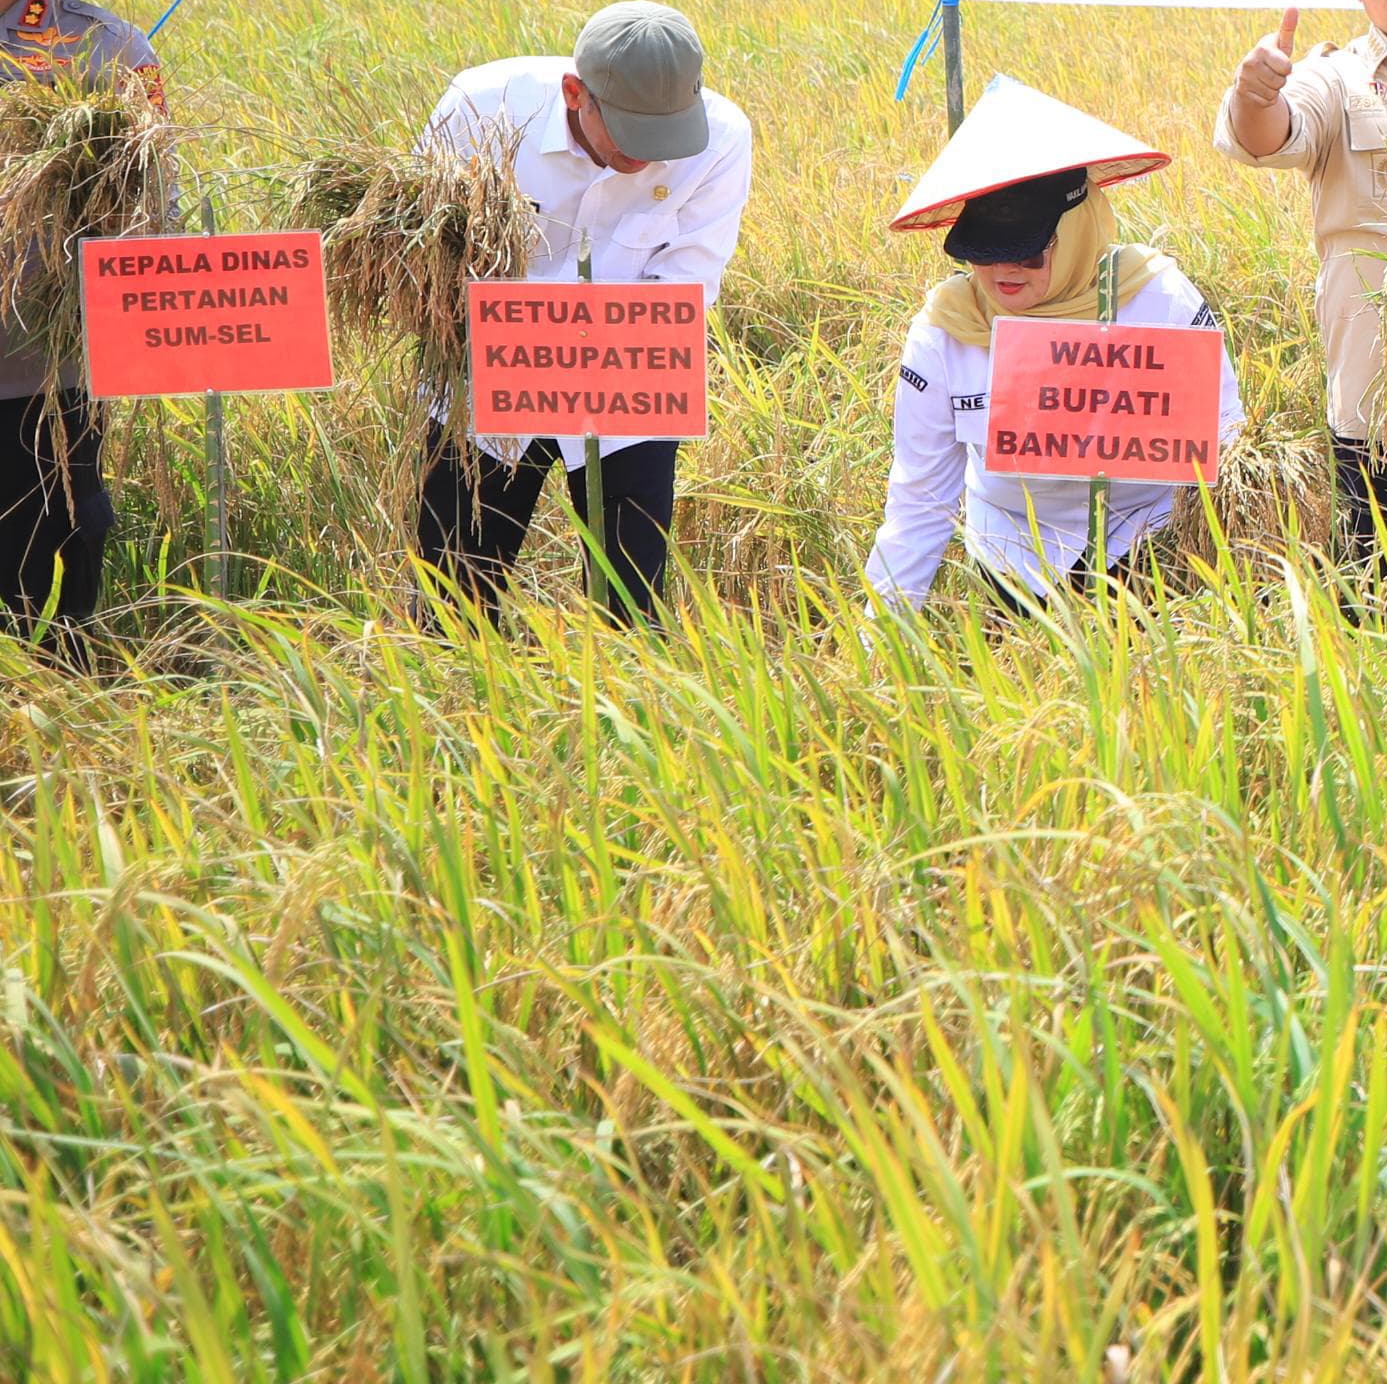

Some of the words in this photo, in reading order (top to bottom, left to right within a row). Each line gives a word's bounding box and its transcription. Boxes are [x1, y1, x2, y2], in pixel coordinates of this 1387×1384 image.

[98, 253, 213, 277] KEPALA
[221, 248, 310, 270] DINAS
[121, 286, 288, 313] PERTANIAN
[479, 300, 593, 324] KETUA
[604, 302, 696, 325] DPRD
[144, 323, 271, 348] SUM-SEL
[485, 345, 692, 370] KABUPATEN
[1050, 340, 1165, 370] WAKIL
[491, 389, 689, 415] BANYUASIN
[1038, 386, 1171, 416] BUPATI
[996, 429, 1209, 465] BANYUASIN
